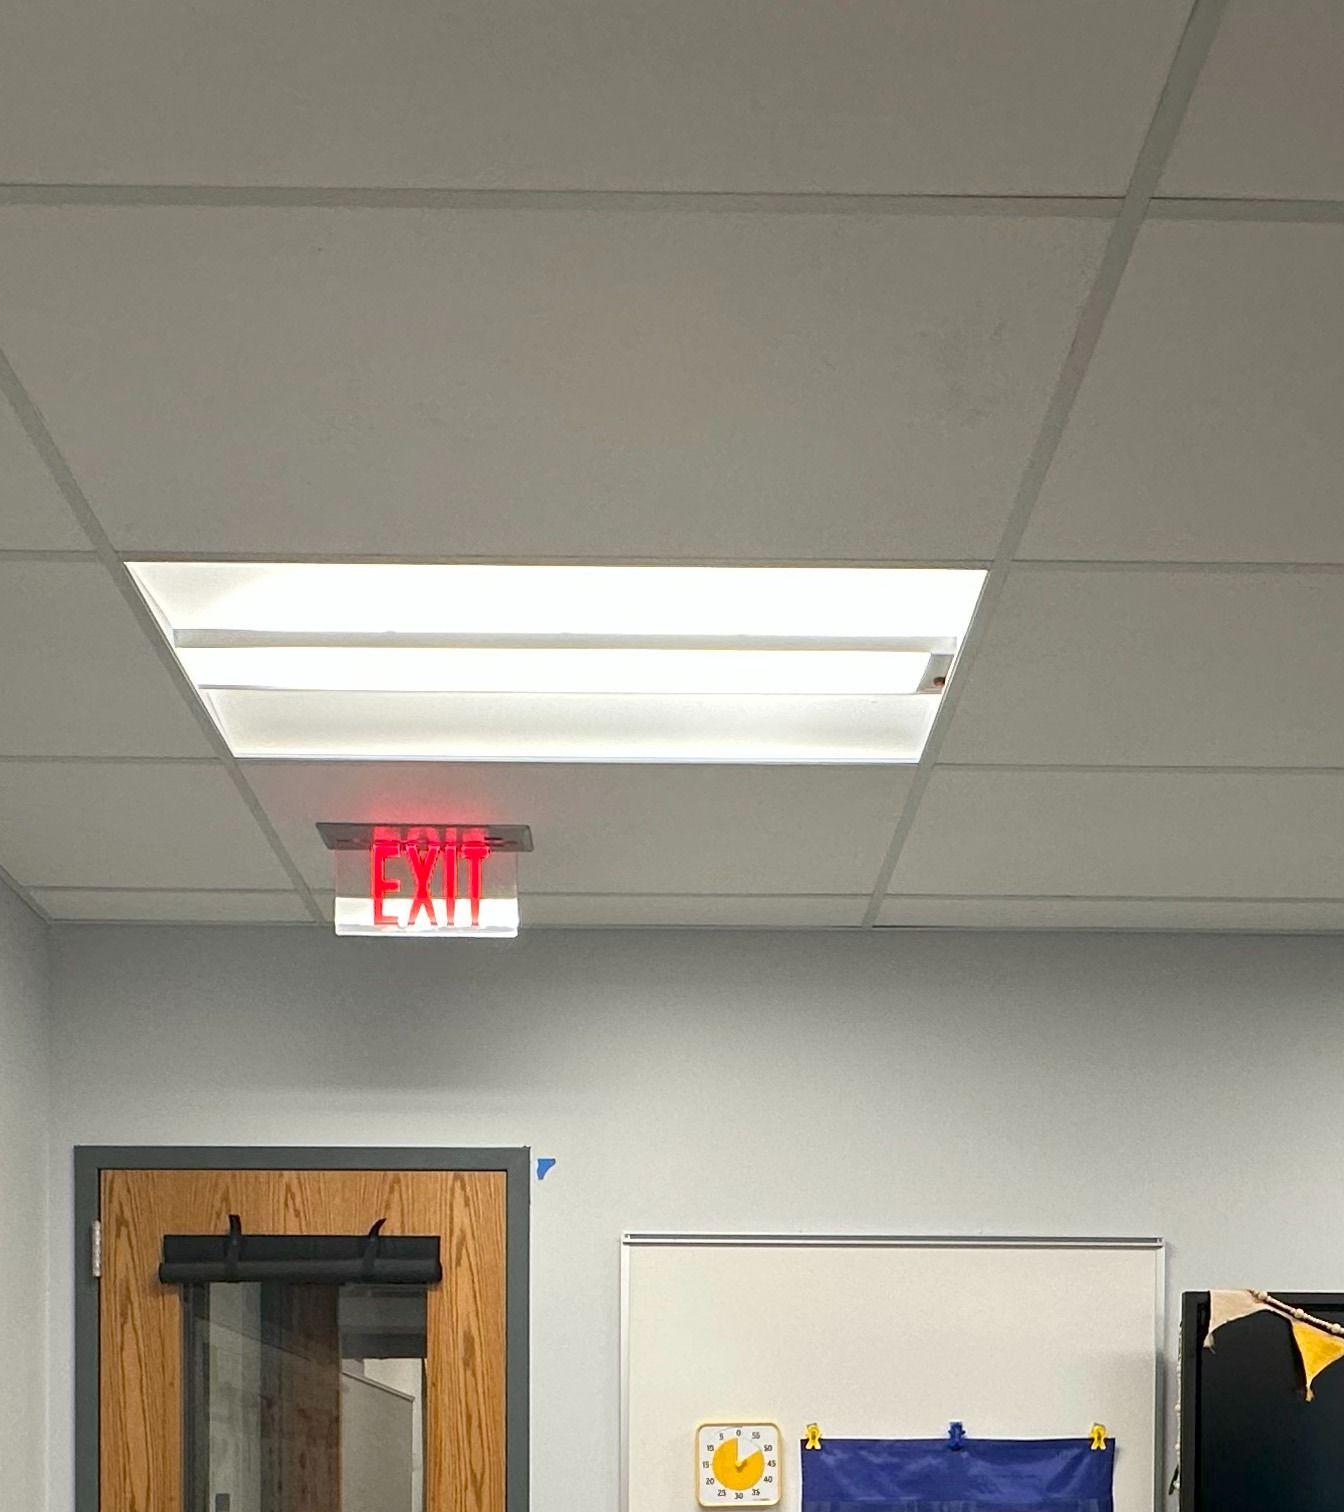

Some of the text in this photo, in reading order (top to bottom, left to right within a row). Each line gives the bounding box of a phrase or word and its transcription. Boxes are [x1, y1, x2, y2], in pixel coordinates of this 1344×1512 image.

[370, 844, 490, 927] EXIT
[767, 1460, 777, 1468] 45
[763, 1475, 773, 1483] 40
